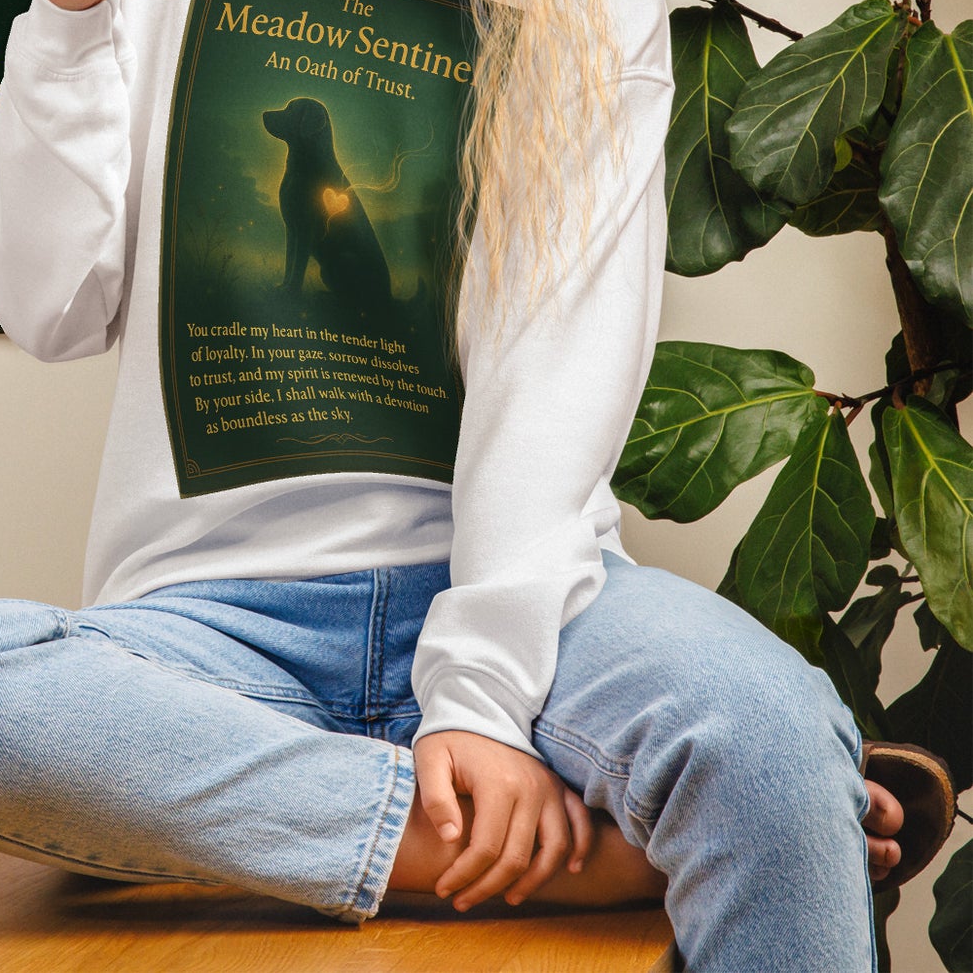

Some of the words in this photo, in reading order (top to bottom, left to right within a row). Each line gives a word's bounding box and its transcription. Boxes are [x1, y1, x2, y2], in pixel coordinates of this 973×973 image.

[215, 2, 351, 49] Meadow
[265, 51, 291, 70] An
[295, 55, 338, 80] Oath
[343, 67, 363, 85] of
[366, 71, 415, 100] Trust.
[187, 323, 208, 337] You
[211, 322, 247, 336] cradle
[250, 326, 268, 340] my
[272, 324, 303, 338] heart
[306, 327, 317, 339] in
[320, 329, 339, 342] the
[342, 334, 377, 349] tender
[380, 339, 406, 355] light
[191, 347, 204, 362] of
[206, 346, 248, 363] loyalty.
[251, 346, 265, 359] In
[268, 349, 295, 363] your
[299, 349, 327, 361] gaze,
[329, 352, 367, 365] sorrow
[371, 355, 419, 375] dissolves
[190, 373, 201, 387] to
[204, 371, 236, 386] trust,
[239, 368, 262, 382] and
[265, 369, 285, 383] my
[288, 367, 318, 383] spirit
[321, 368, 330, 379] is
[333, 371, 379, 385] renewed
[382, 374, 395, 391] by
[397, 379, 414, 392] the
[195, 397, 210, 415] By
[213, 396, 241, 412] your
[245, 390, 274, 404] side,
[277, 389, 282, 401] I
[285, 387, 316, 401] shall
[318, 388, 345, 400] walk
[349, 390, 373, 403] with
[375, 395, 382, 404] a
[384, 394, 429, 414] devotion
[206, 421, 219, 435] as
[220, 411, 288, 432] boundless
[291, 411, 305, 423] as
[308, 407, 328, 422] the
[331, 407, 353, 423] sky.
